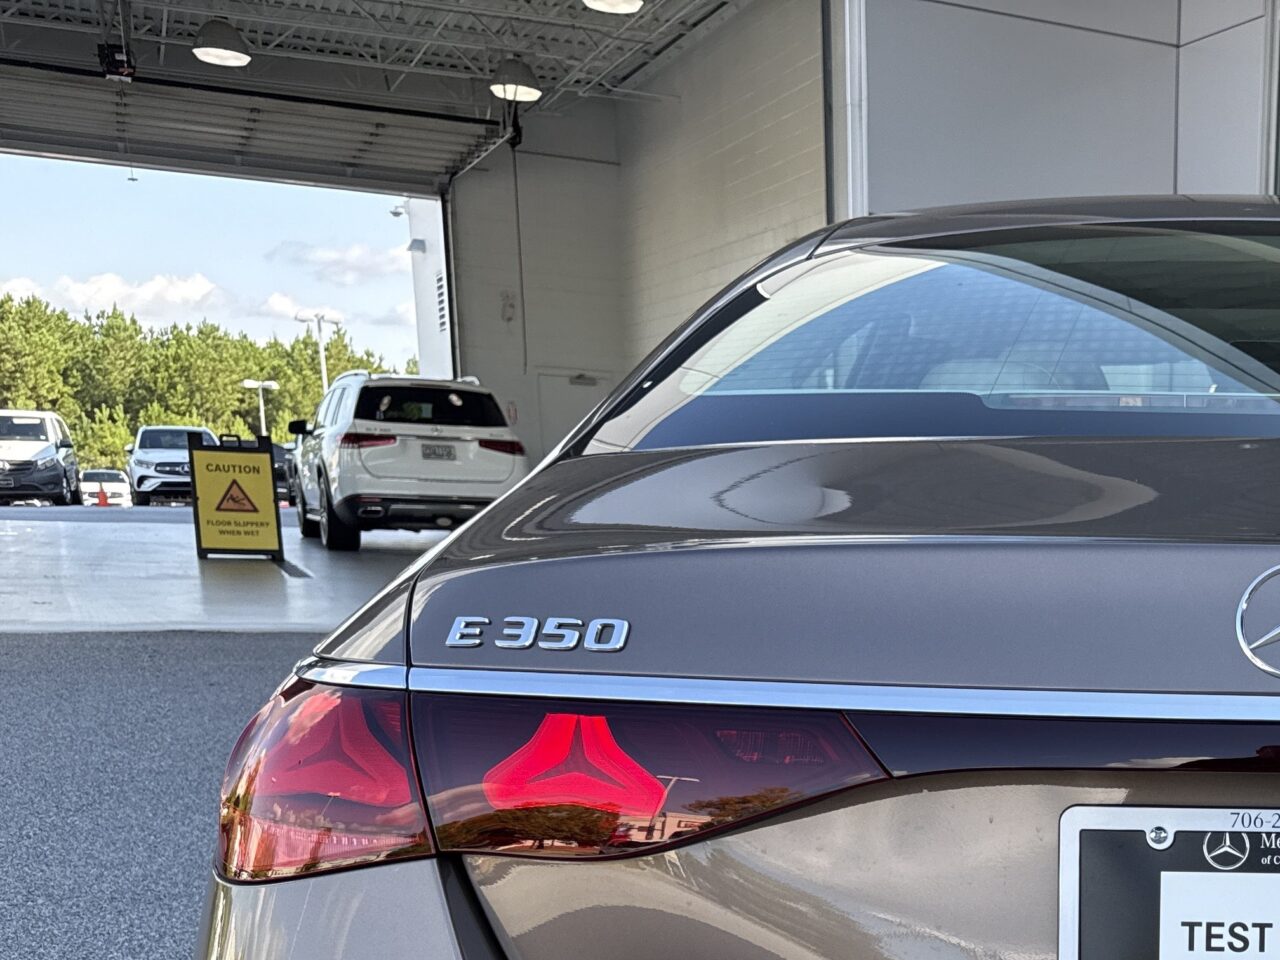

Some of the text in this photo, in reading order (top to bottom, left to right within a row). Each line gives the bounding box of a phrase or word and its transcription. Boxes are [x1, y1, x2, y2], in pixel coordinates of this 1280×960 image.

[206, 463, 261, 475] CAUTION
[206, 519, 270, 528] FLOOR SLIPPERY
[218, 529, 242, 537] WHEN
[445, 616, 631, 651] E 350
[1261, 855, 1271, 866] of
[1181, 921, 1273, 952] TEST
